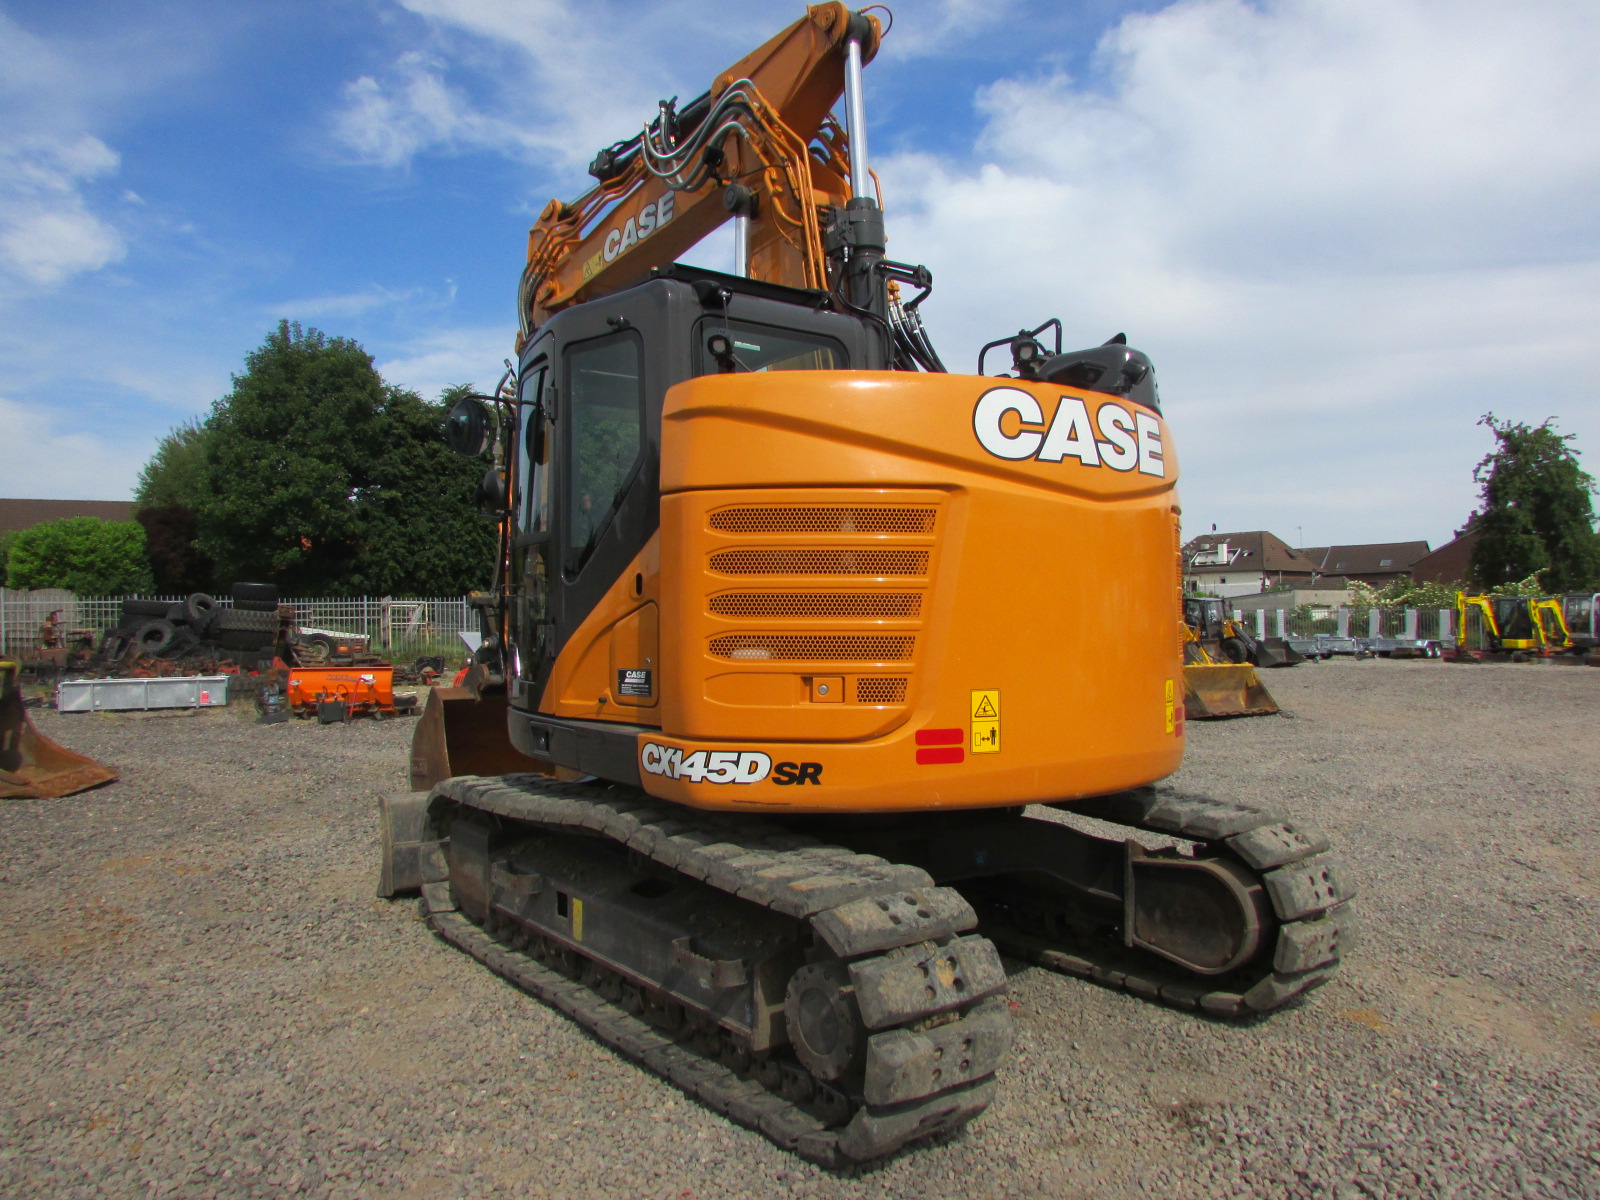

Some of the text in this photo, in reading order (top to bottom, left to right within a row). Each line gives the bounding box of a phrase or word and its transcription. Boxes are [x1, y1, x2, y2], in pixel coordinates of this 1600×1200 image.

[603, 190, 675, 263] CASE
[973, 387, 1165, 478] CASE
[626, 671, 646, 679] CASE
[641, 742, 823, 785] CX145D SR
